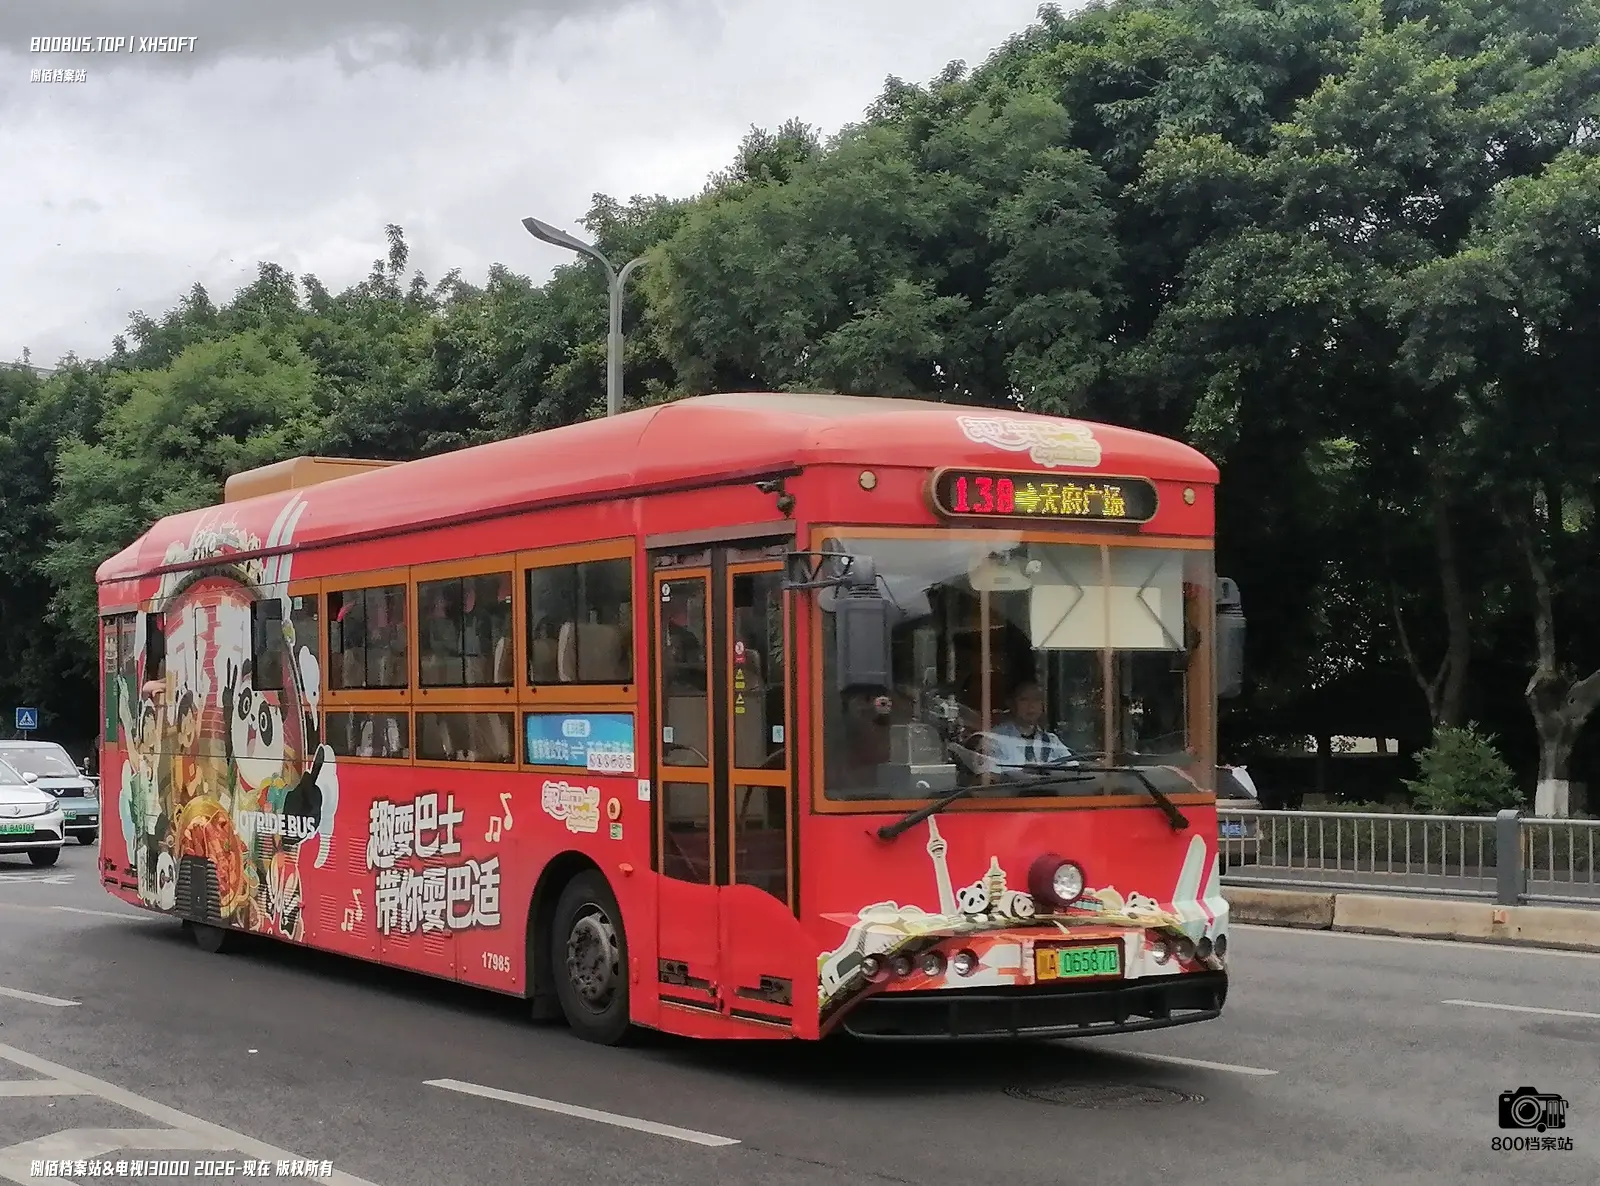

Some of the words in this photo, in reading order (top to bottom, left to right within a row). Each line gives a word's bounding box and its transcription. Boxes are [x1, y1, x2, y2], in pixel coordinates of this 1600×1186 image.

[287, 814, 316, 840] BUS
[366, 793, 464, 870] 趣耍巴士
[375, 857, 501, 936] 带你耍巴适
[481, 951, 511, 973] 17985
